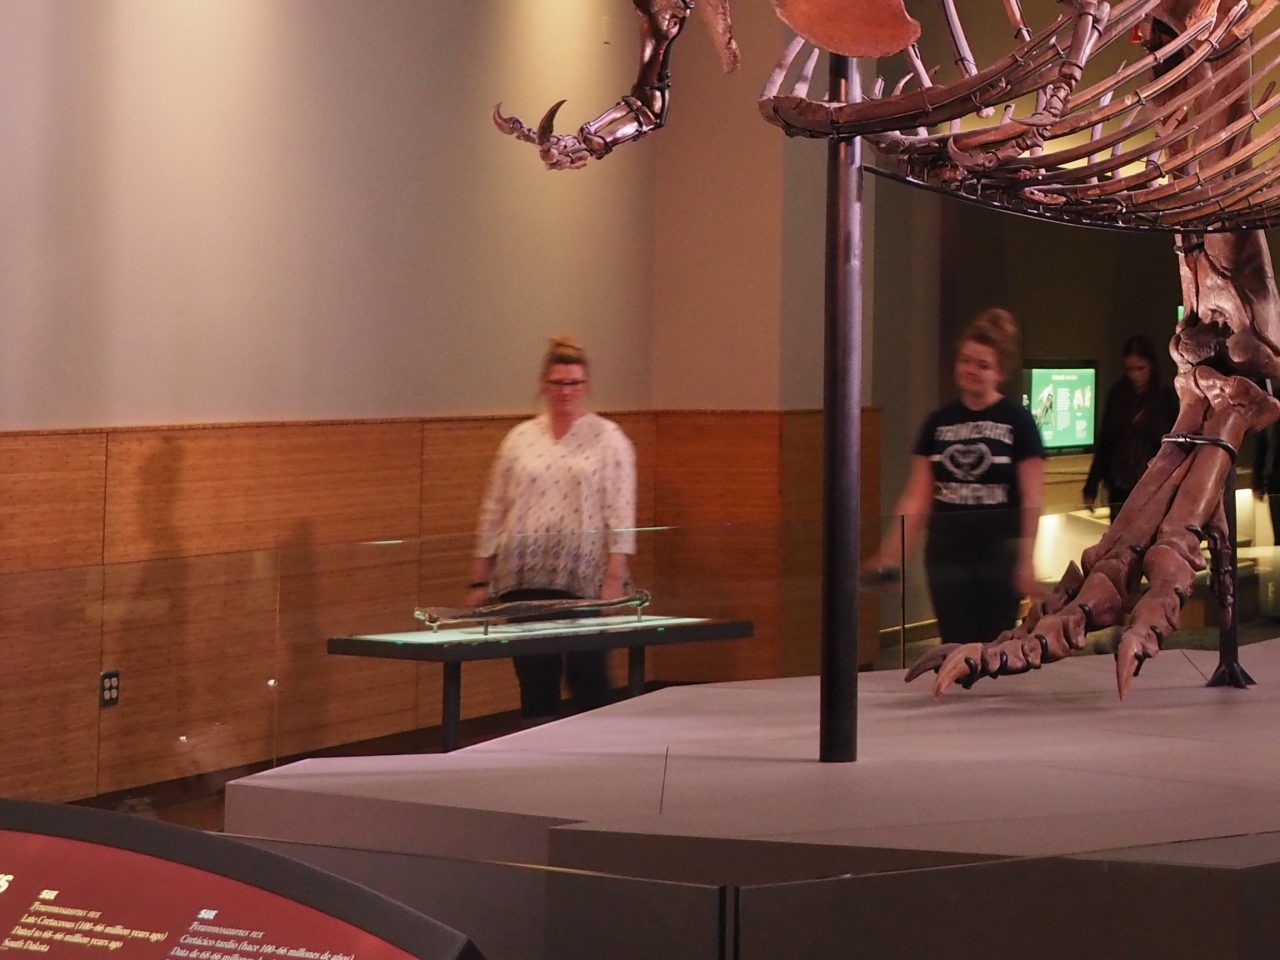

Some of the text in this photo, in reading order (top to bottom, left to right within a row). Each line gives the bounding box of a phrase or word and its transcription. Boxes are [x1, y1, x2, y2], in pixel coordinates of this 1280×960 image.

[29, 901, 102, 919] Tyrannosaurus rex
[197, 908, 219, 920] SUE
[20, 913, 38, 924] Late
[37, 916, 76, 929] Cretaceous
[103, 924, 131, 936] million
[128, 929, 150, 939] years
[149, 931, 168, 942] ago)
[189, 921, 265, 939] Tyrannosaurus rex
[1, 938, 50, 952] South Dakota
[11, 926, 36, 937] Dated
[33, 928, 43, 938] to
[63, 933, 90, 944] million
[87, 938, 109, 948] years
[107, 940, 124, 950] ago
[180, 933, 216, 946] Cretácico
[238, 940, 260, 952] (hace
[287, 947, 321, 959] millones
[320, 950, 332, 960] de
[170, 946, 190, 957] Data
[188, 949, 200, 959] de
